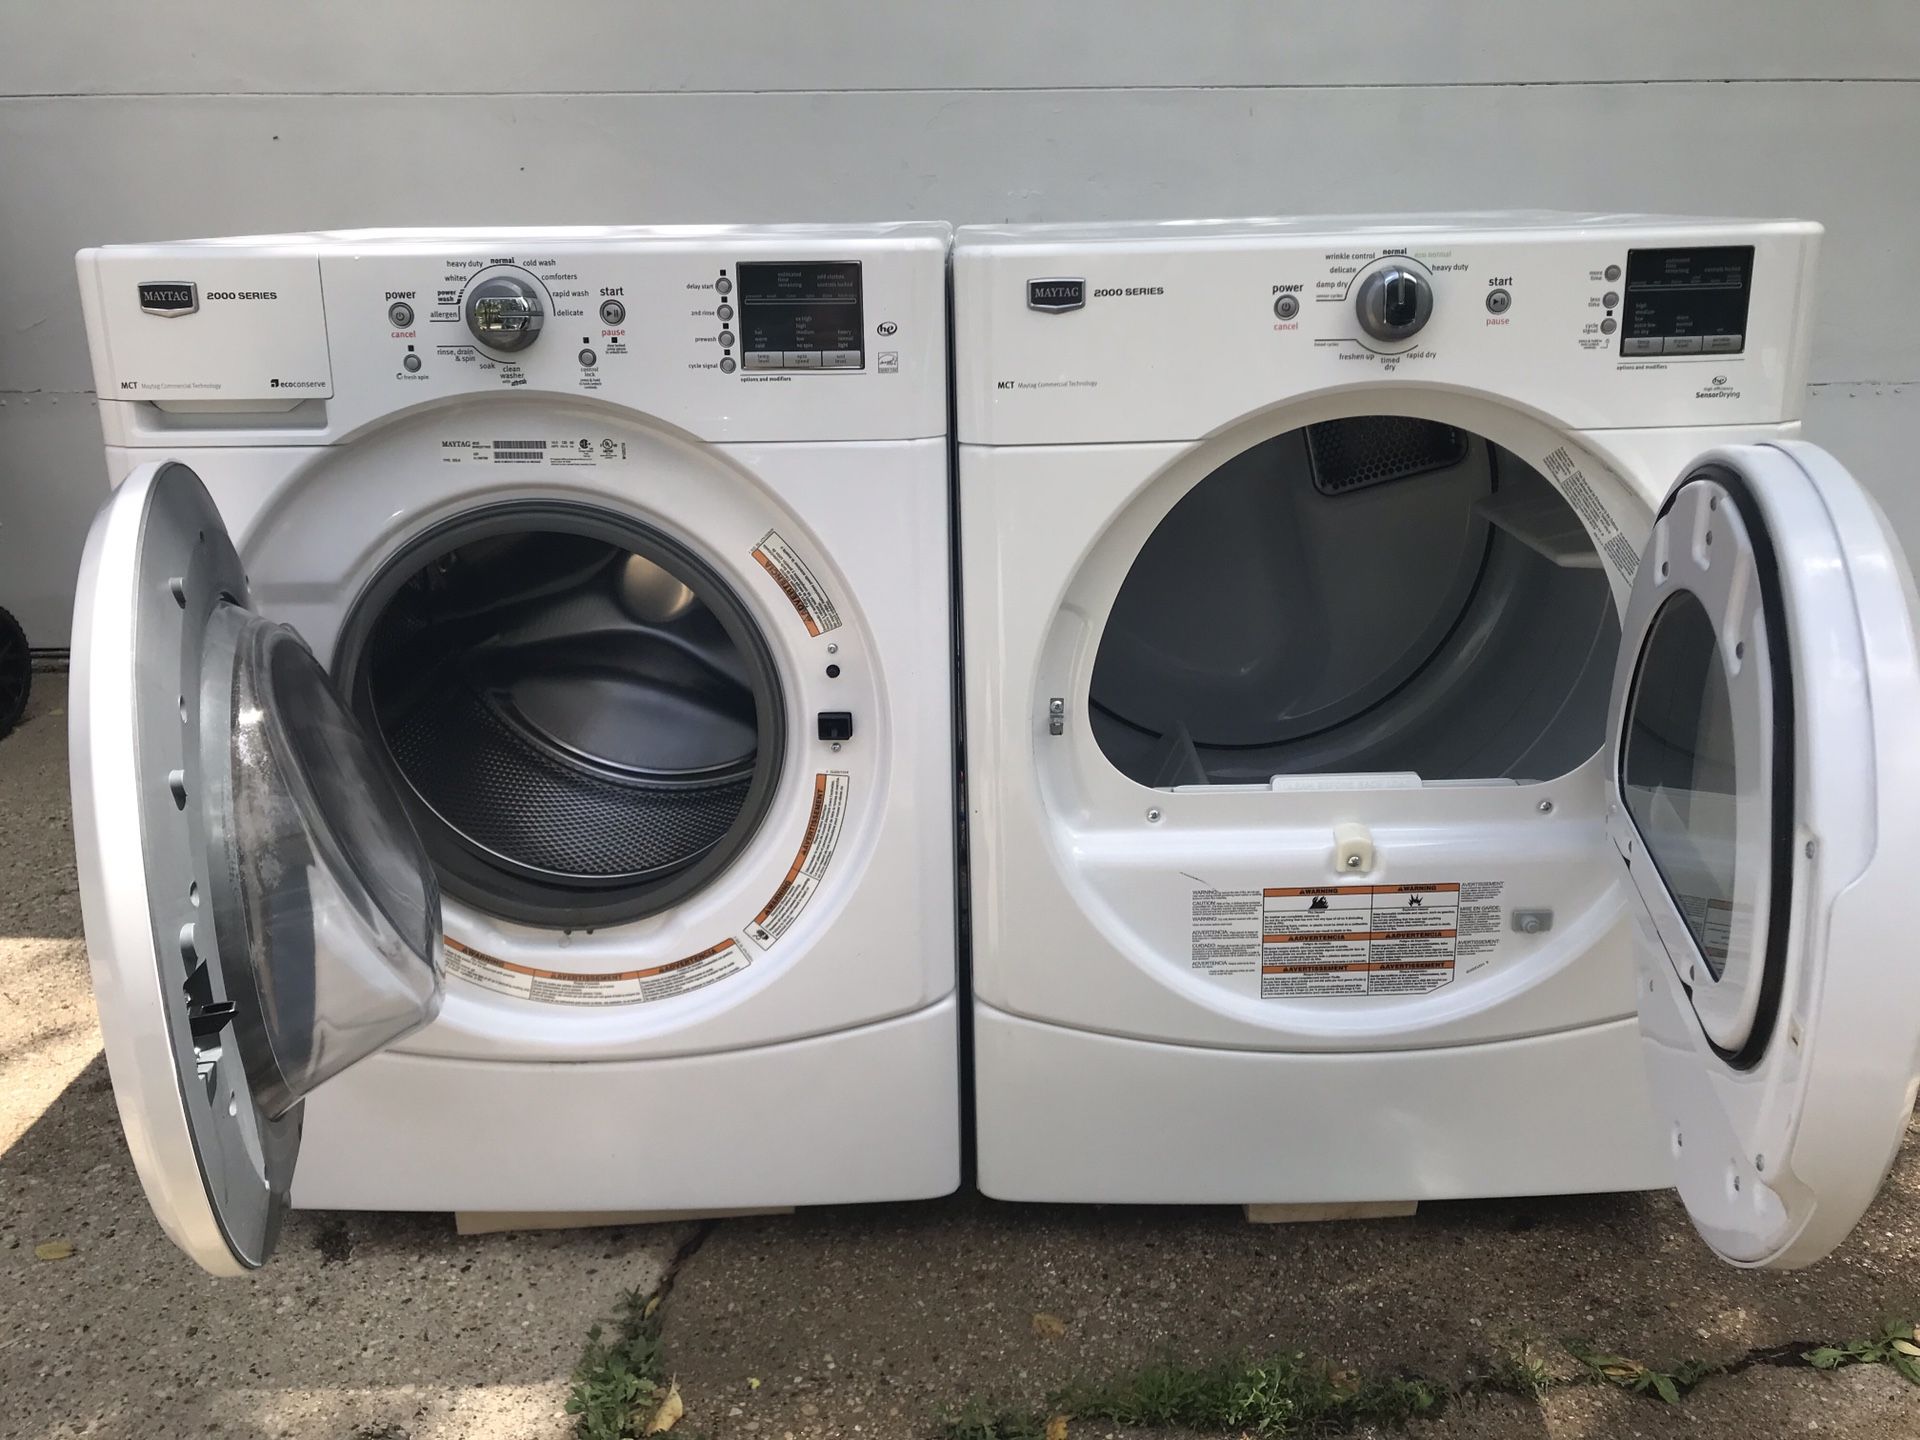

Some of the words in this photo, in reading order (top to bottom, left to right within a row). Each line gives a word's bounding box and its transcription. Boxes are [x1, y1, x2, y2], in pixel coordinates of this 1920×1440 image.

[1382, 247, 1407, 256] normal
[490, 256, 515, 264] normal
[1325, 252, 1350, 261] wrinkle
[1351, 252, 1375, 260] control
[446, 260, 462, 268] heavy
[463, 260, 483, 268] duty
[1431, 263, 1452, 272] heavy
[1452, 263, 1468, 272] duty
[1329, 265, 1357, 274] delicate
[444, 274, 467, 282] whites
[541, 273, 578, 281] comforters
[1488, 276, 1513, 287] start
[686, 283, 700, 291] delay
[1271, 283, 1304, 295] power
[1316, 281, 1335, 290] damp
[1336, 280, 1348, 289] dry
[385, 290, 416, 301] power
[552, 290, 569, 298] rapid
[571, 289, 589, 297] wash
[600, 286, 624, 296] start
[1035, 287, 1080, 298] MAYTAG
[1094, 288, 1123, 297] 2000
[1125, 286, 1164, 296] SERIES
[144, 290, 188, 302] MAYTAG
[207, 292, 236, 300] 2000
[238, 292, 277, 300] SERIES
[430, 310, 458, 319] allergen
[557, 308, 583, 317] delicate
[1273, 322, 1298, 331] cancel
[1485, 317, 1510, 327] pause
[391, 330, 416, 338] cancel
[601, 328, 625, 337] pause
[1339, 353, 1364, 361] freshen
[1365, 353, 1374, 361] up
[1406, 351, 1424, 360] rapid
[1424, 350, 1436, 359] dry
[1380, 356, 1400, 364] timed
[1384, 363, 1396, 372] dry
[121, 381, 138, 390] MCT
[280, 379, 326, 388] ecoconserve
[997, 381, 1015, 389] MCT
[1695, 391, 1741, 399] SensorDrying
[441, 440, 471, 448] MAYTAG
